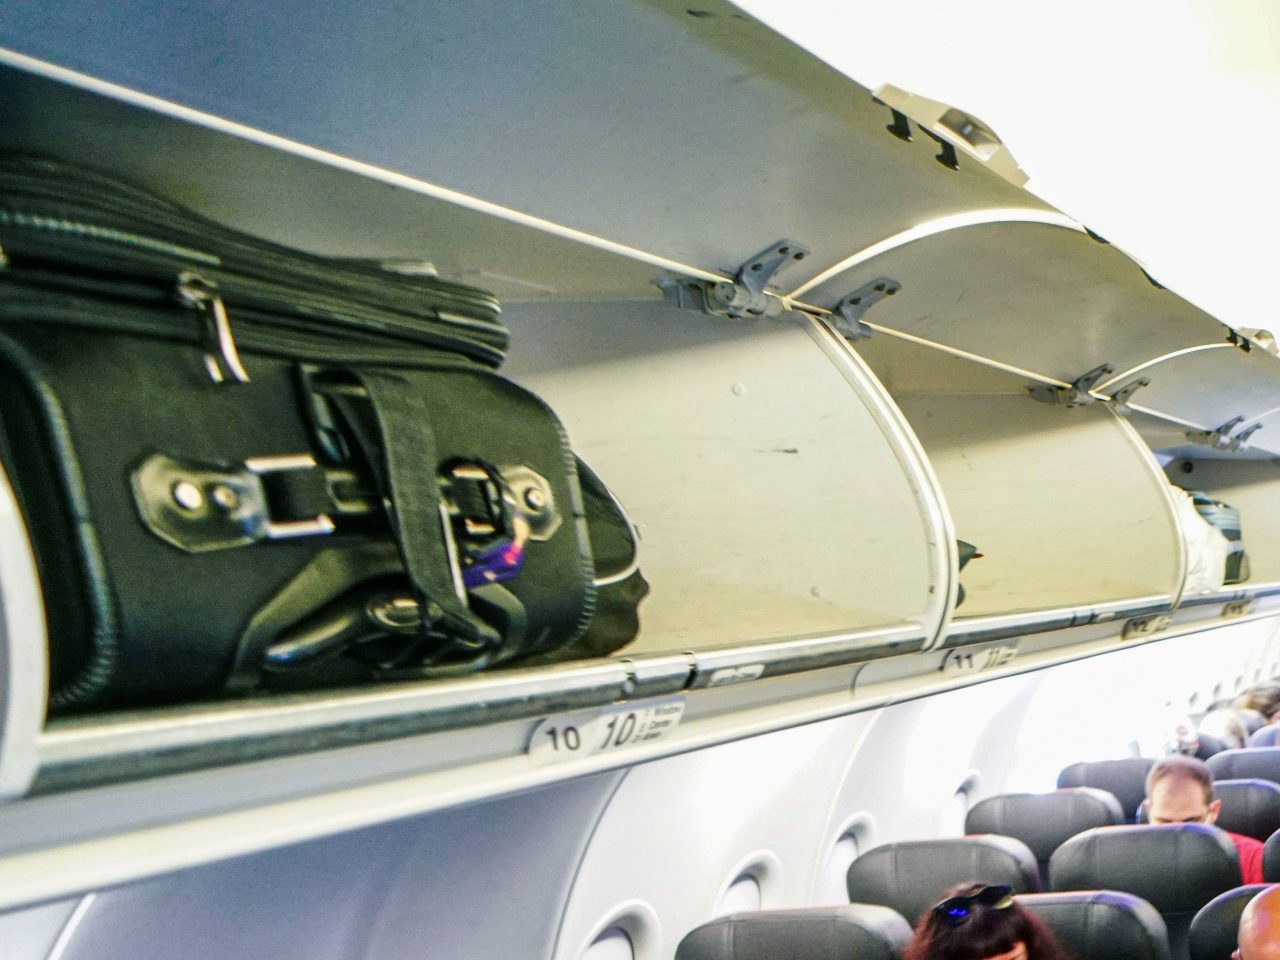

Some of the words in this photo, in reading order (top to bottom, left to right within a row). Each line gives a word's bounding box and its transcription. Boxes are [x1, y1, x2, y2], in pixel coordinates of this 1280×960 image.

[954, 654, 973, 669] 11
[545, 726, 581, 750] 10
[600, 712, 637, 750] 10
